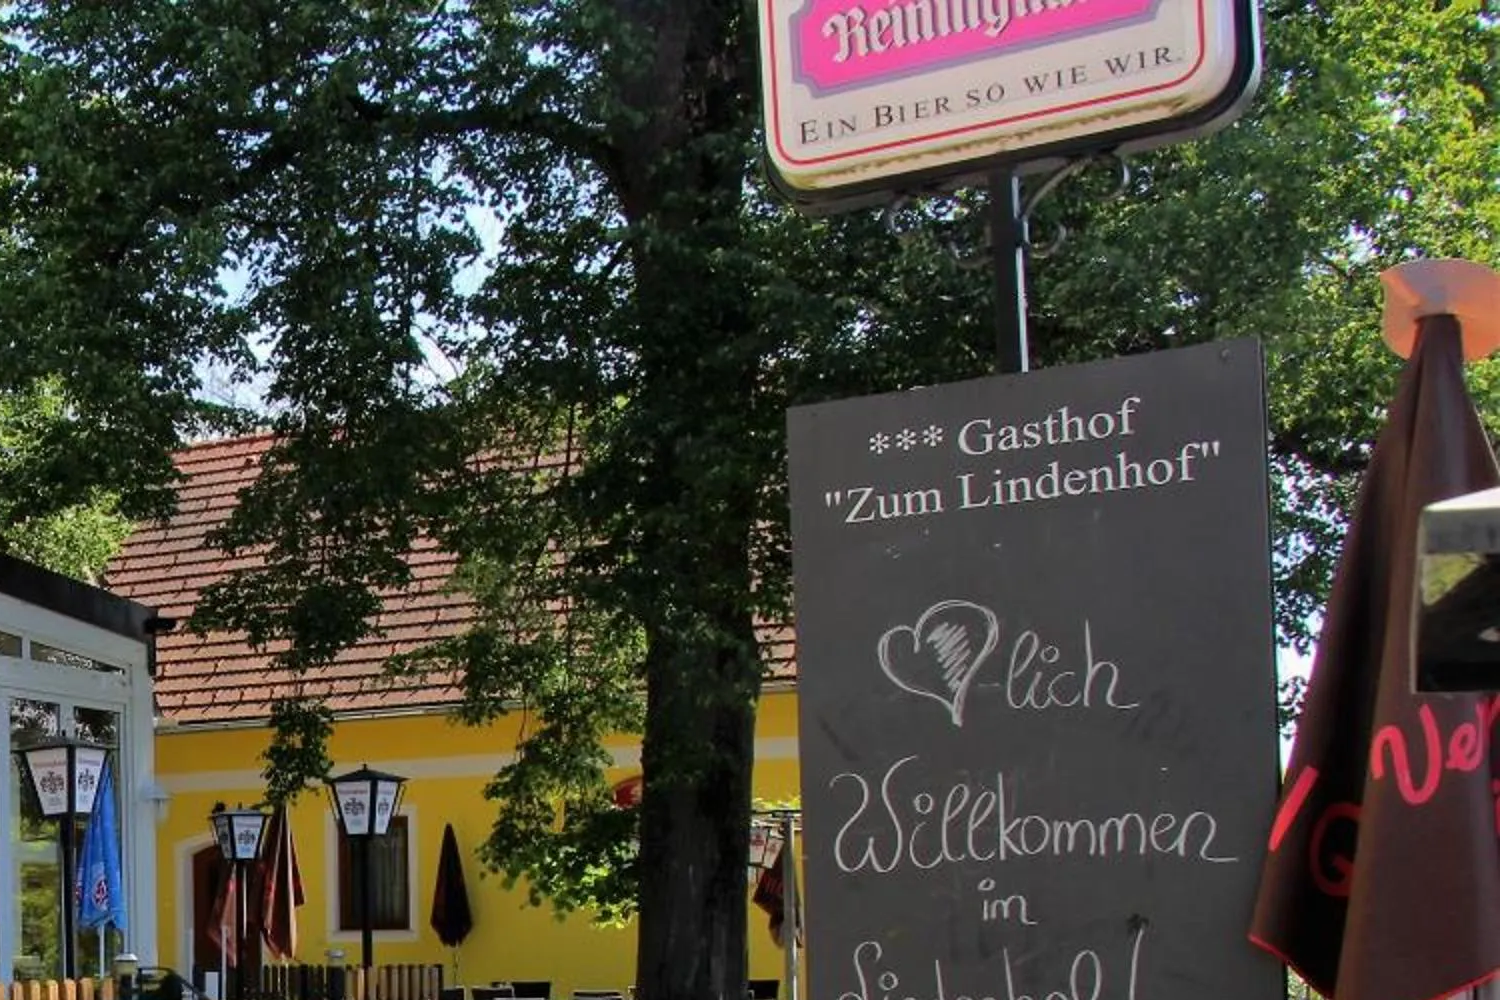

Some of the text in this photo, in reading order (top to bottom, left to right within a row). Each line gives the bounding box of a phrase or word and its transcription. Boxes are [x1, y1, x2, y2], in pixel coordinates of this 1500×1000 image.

[800, 116, 858, 145] EIN
[874, 95, 951, 130] BIER
[965, 84, 1006, 109] SO
[1022, 65, 1088, 96] WIE
[957, 397, 1141, 456] Gasthof
[825, 440, 1222, 524] "Zum Lindenhof"
[828, 754, 1240, 875] Willkommen
[977, 877, 1037, 926] im
